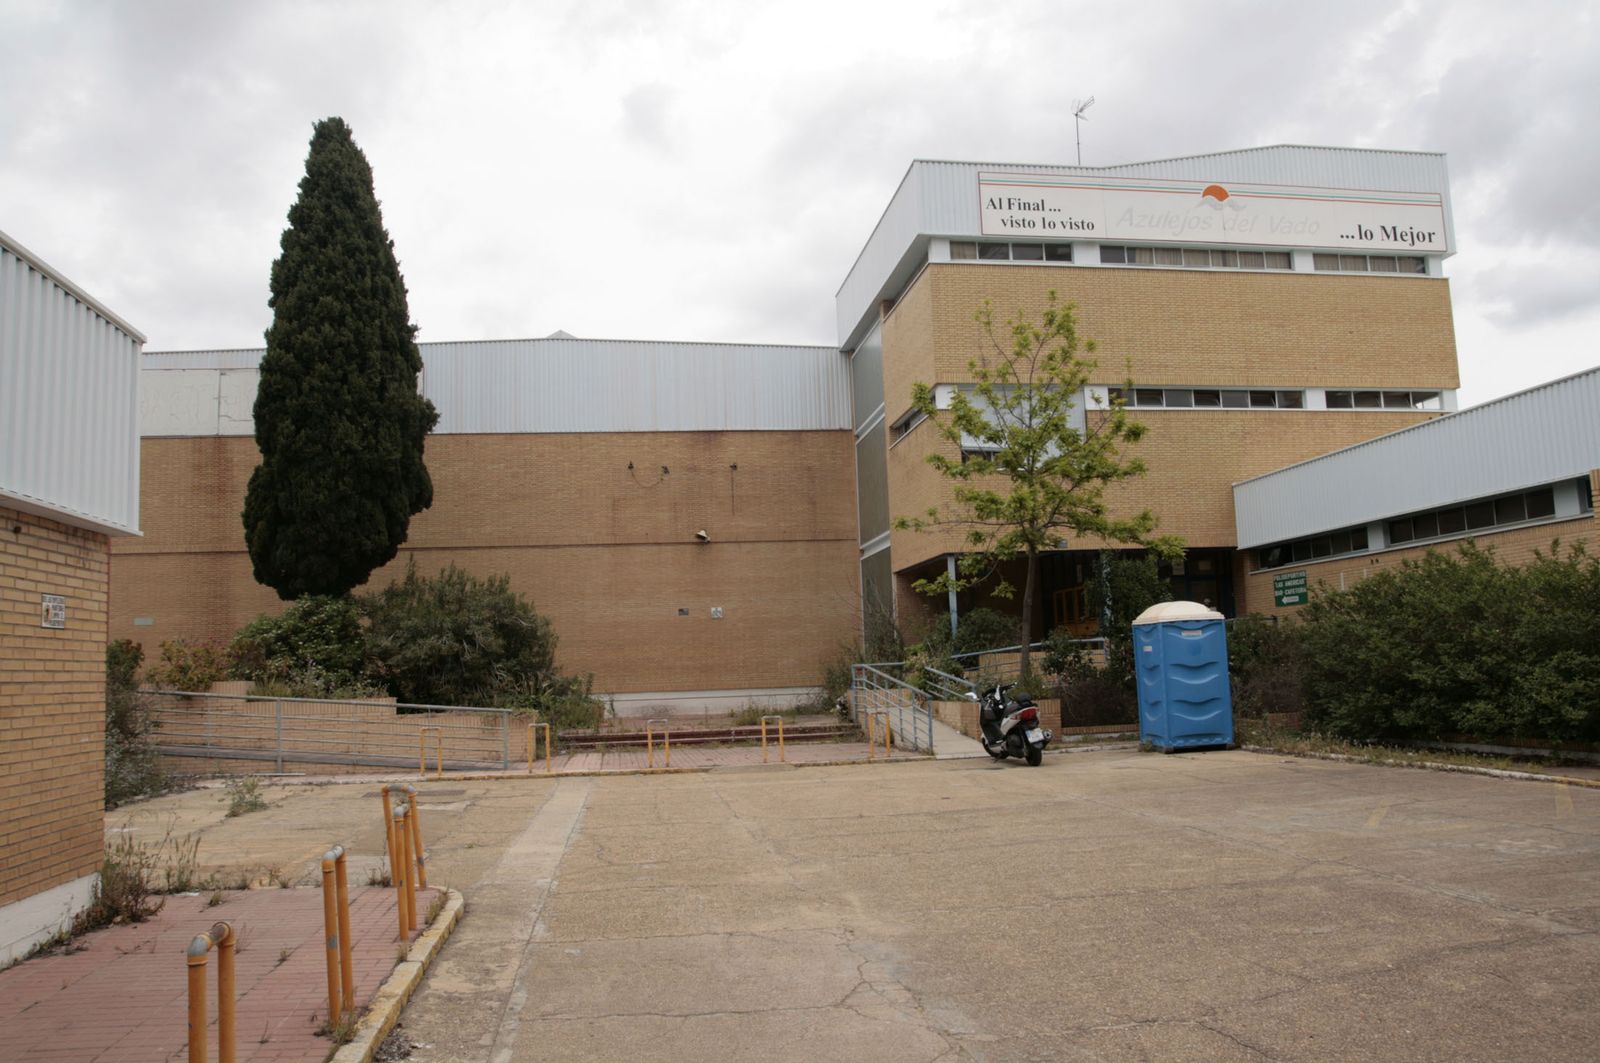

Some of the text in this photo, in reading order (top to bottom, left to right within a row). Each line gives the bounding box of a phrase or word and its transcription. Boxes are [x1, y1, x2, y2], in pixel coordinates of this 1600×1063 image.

[986, 197, 1002, 210] Al
[1001, 216, 1095, 231] visto lo visto
[1116, 206, 1321, 237] Azulejos del Vado
[1380, 225, 1437, 247] Mejor
